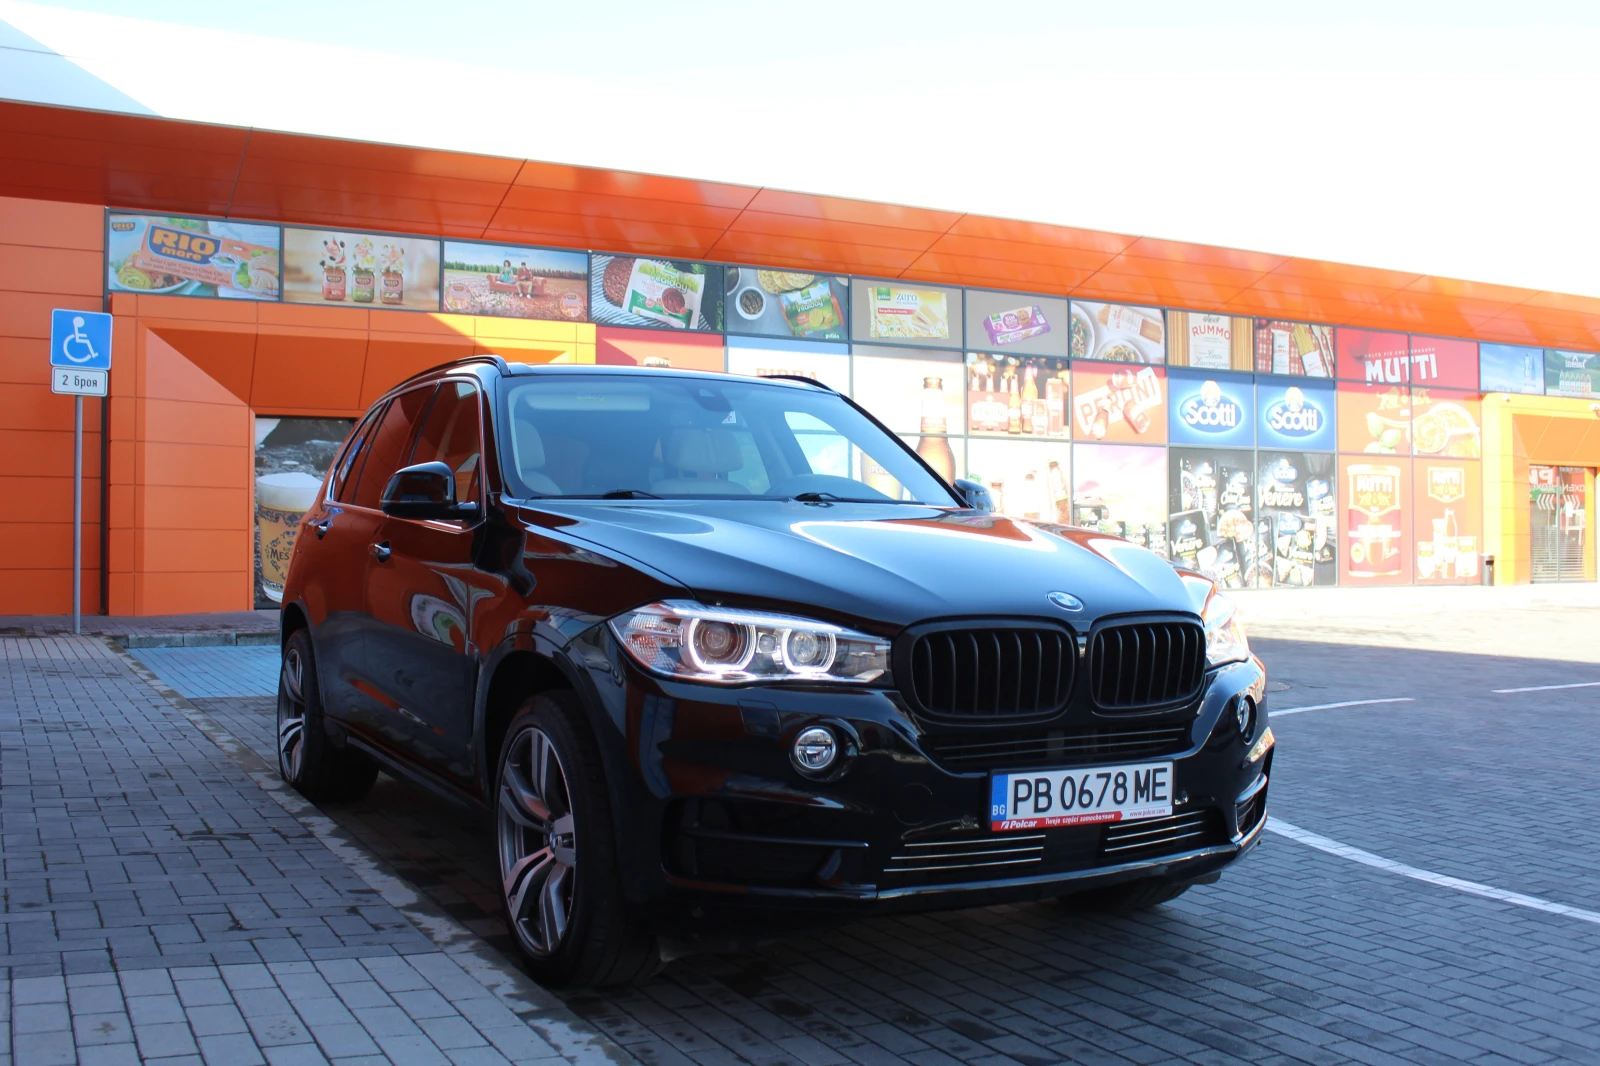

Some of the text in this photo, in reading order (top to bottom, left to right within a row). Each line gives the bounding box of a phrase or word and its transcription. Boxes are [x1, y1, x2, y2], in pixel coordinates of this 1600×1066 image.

[152, 228, 216, 255] RIO
[161, 247, 202, 261] mare
[1192, 325, 1231, 340] RUMMO
[62, 374, 98, 390] 2 броя
[1366, 354, 1437, 386] MUTTI
[1080, 375, 1158, 422] PERONI
[1186, 401, 1236, 427] Scotti
[1271, 406, 1318, 431] Scotti
[1258, 484, 1304, 508] Venere
[1013, 767, 1168, 815] PB 0678 ME
[992, 804, 1006, 816] BG
[1009, 820, 1038, 829] Polcar
[1045, 817, 1061, 825] Twoje
[1129, 807, 1166, 817] www.polcar.com
